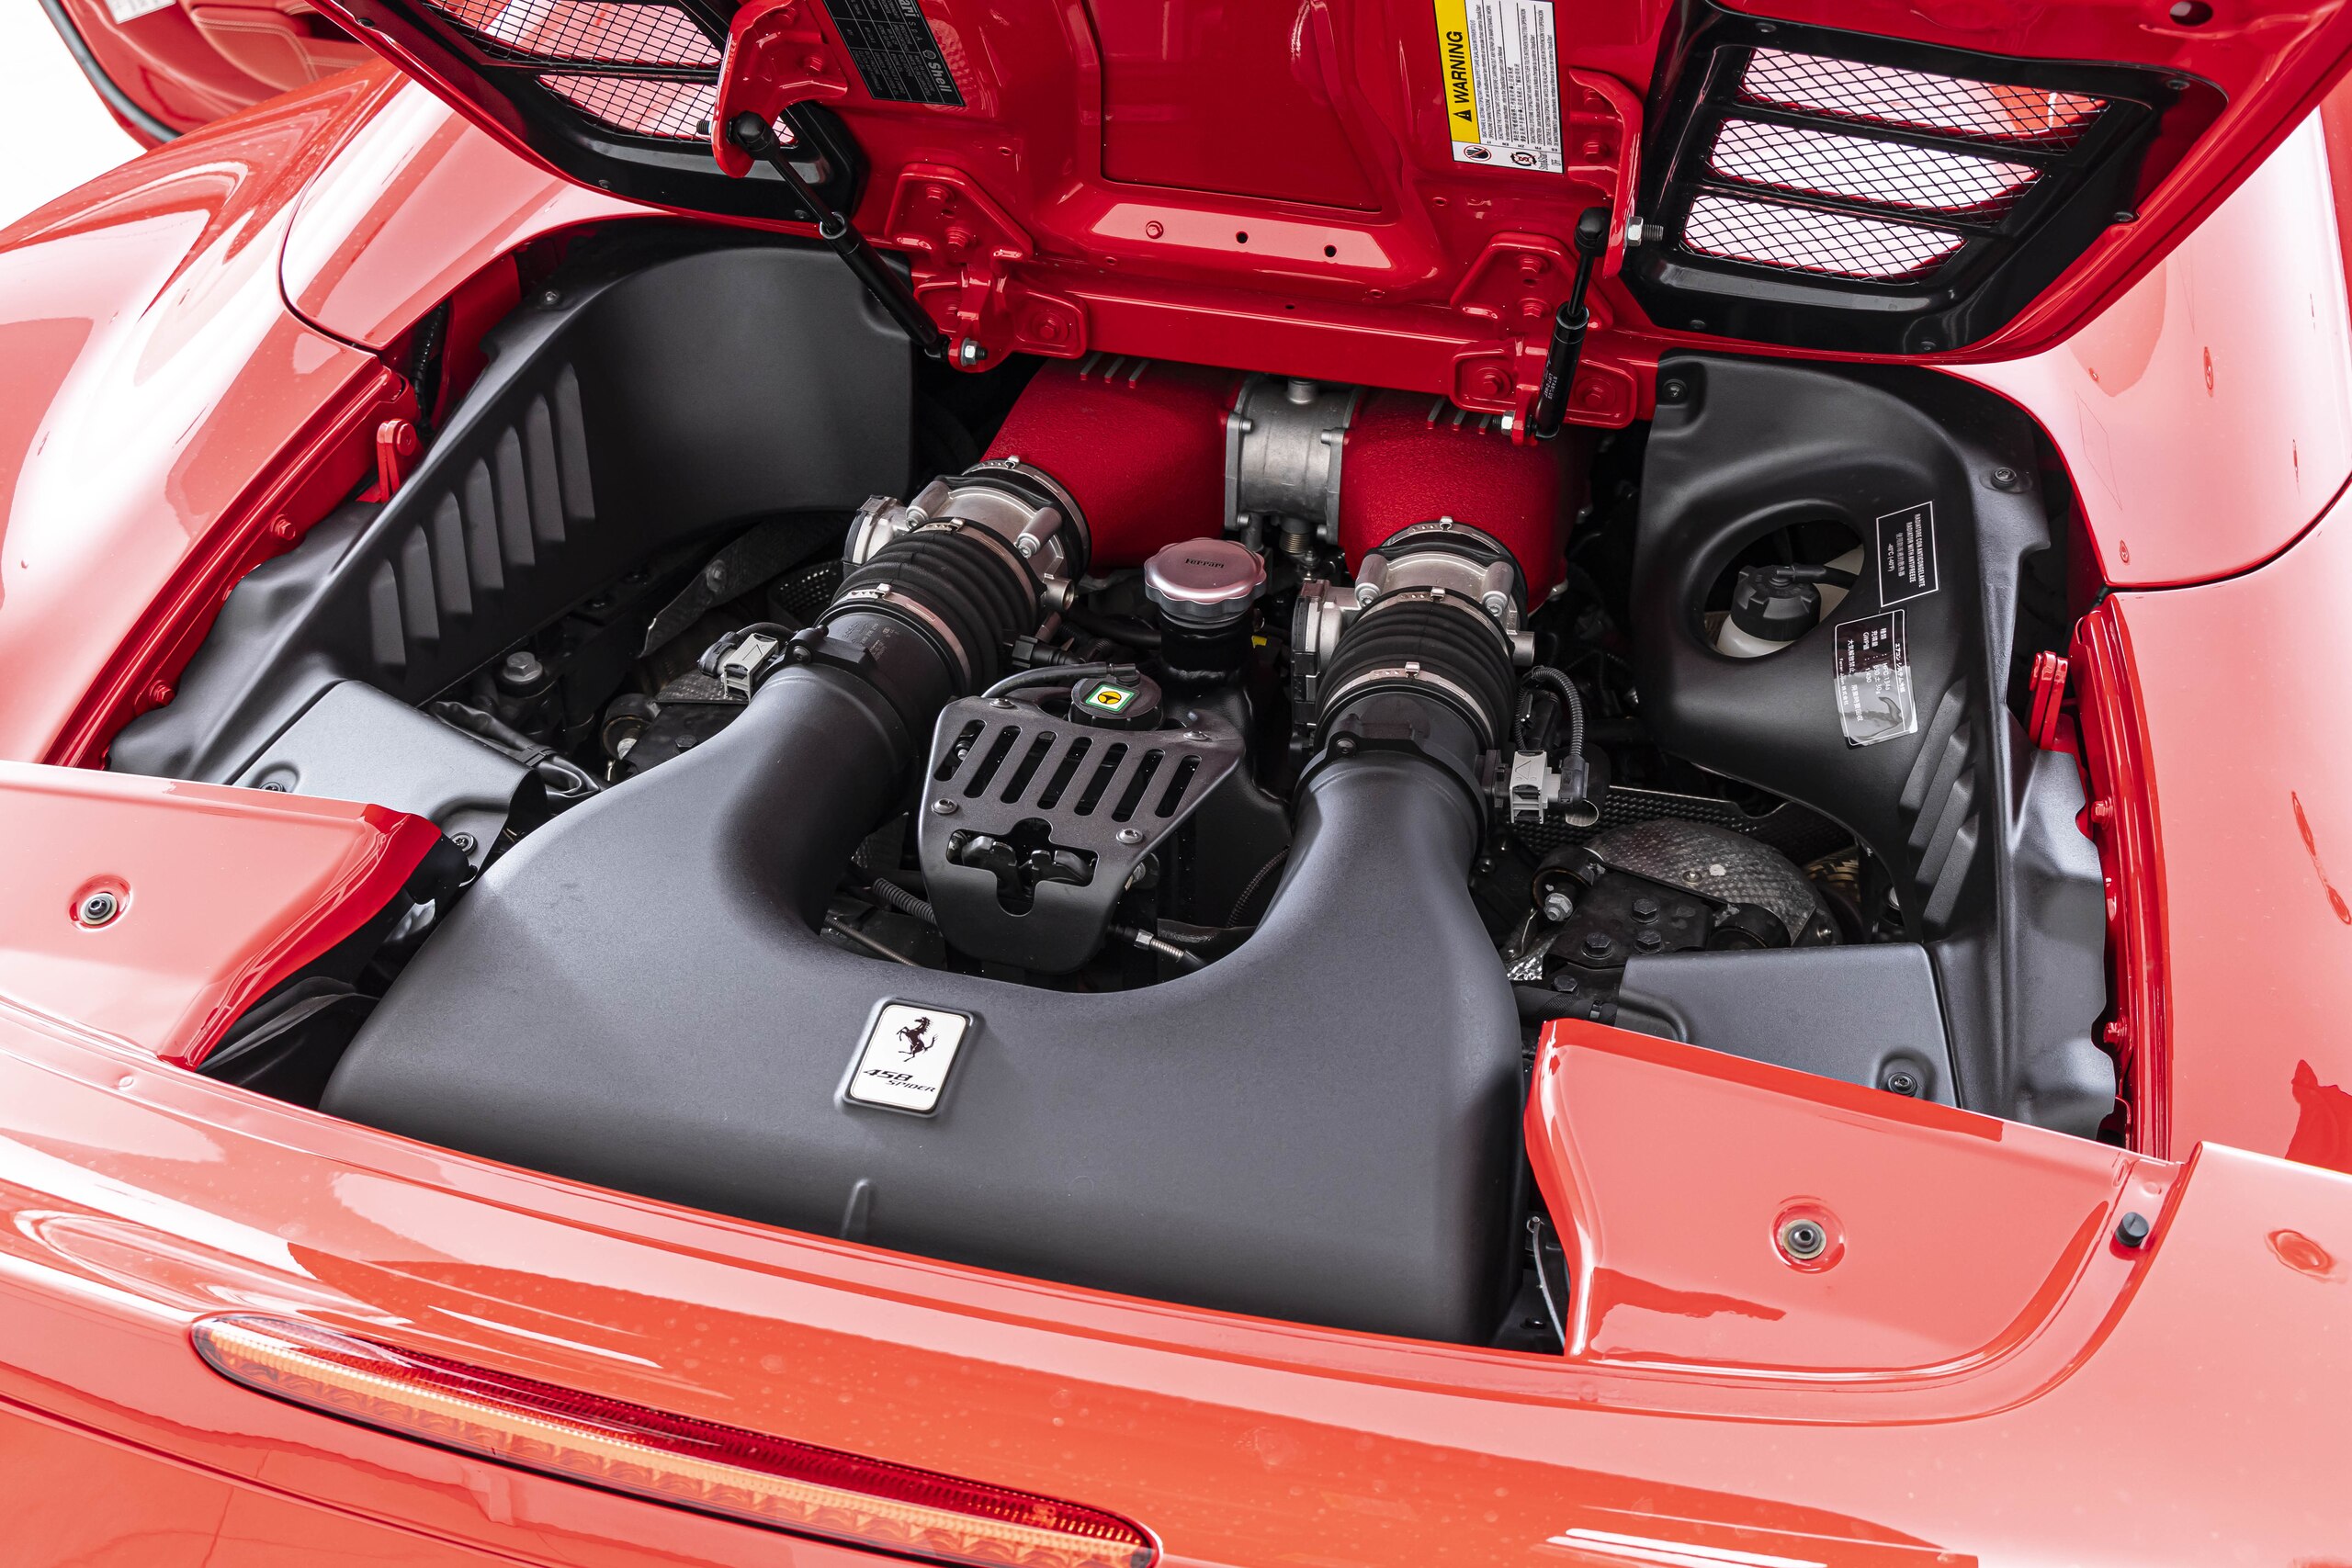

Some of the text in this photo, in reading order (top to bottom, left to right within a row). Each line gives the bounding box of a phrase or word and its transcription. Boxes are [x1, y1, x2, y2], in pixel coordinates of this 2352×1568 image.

[1446, 30, 1472, 104] WARNING
[928, 62, 953, 93] Shell
[1184, 558, 1225, 569] Ferrari
[863, 1068, 913, 1082] 458
[885, 1079, 936, 1093] SPIDER
